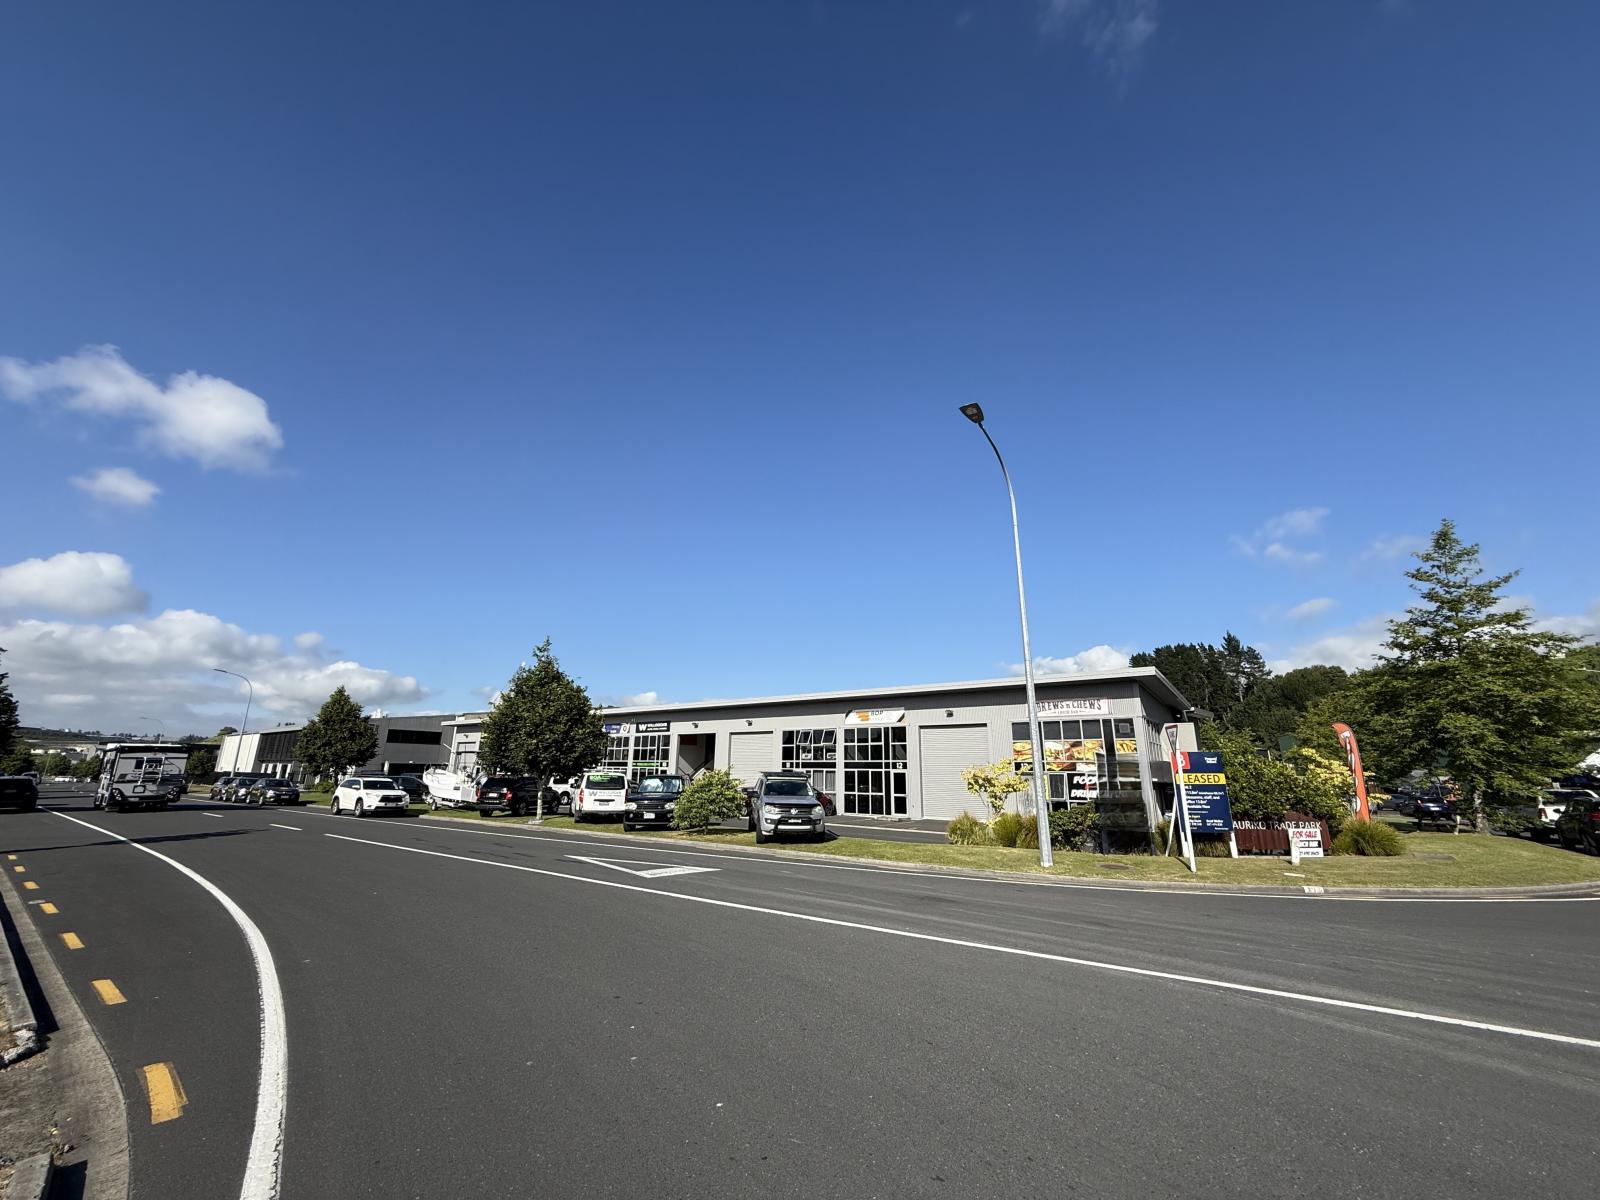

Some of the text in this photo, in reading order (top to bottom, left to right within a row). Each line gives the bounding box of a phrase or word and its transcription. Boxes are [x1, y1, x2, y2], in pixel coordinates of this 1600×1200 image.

[1072, 699, 1102, 710] CHEWS
[1232, 820, 1266, 830] AURIKO
[1299, 821, 1322, 830] PARK
[1292, 830, 1317, 838] FOR SALE
